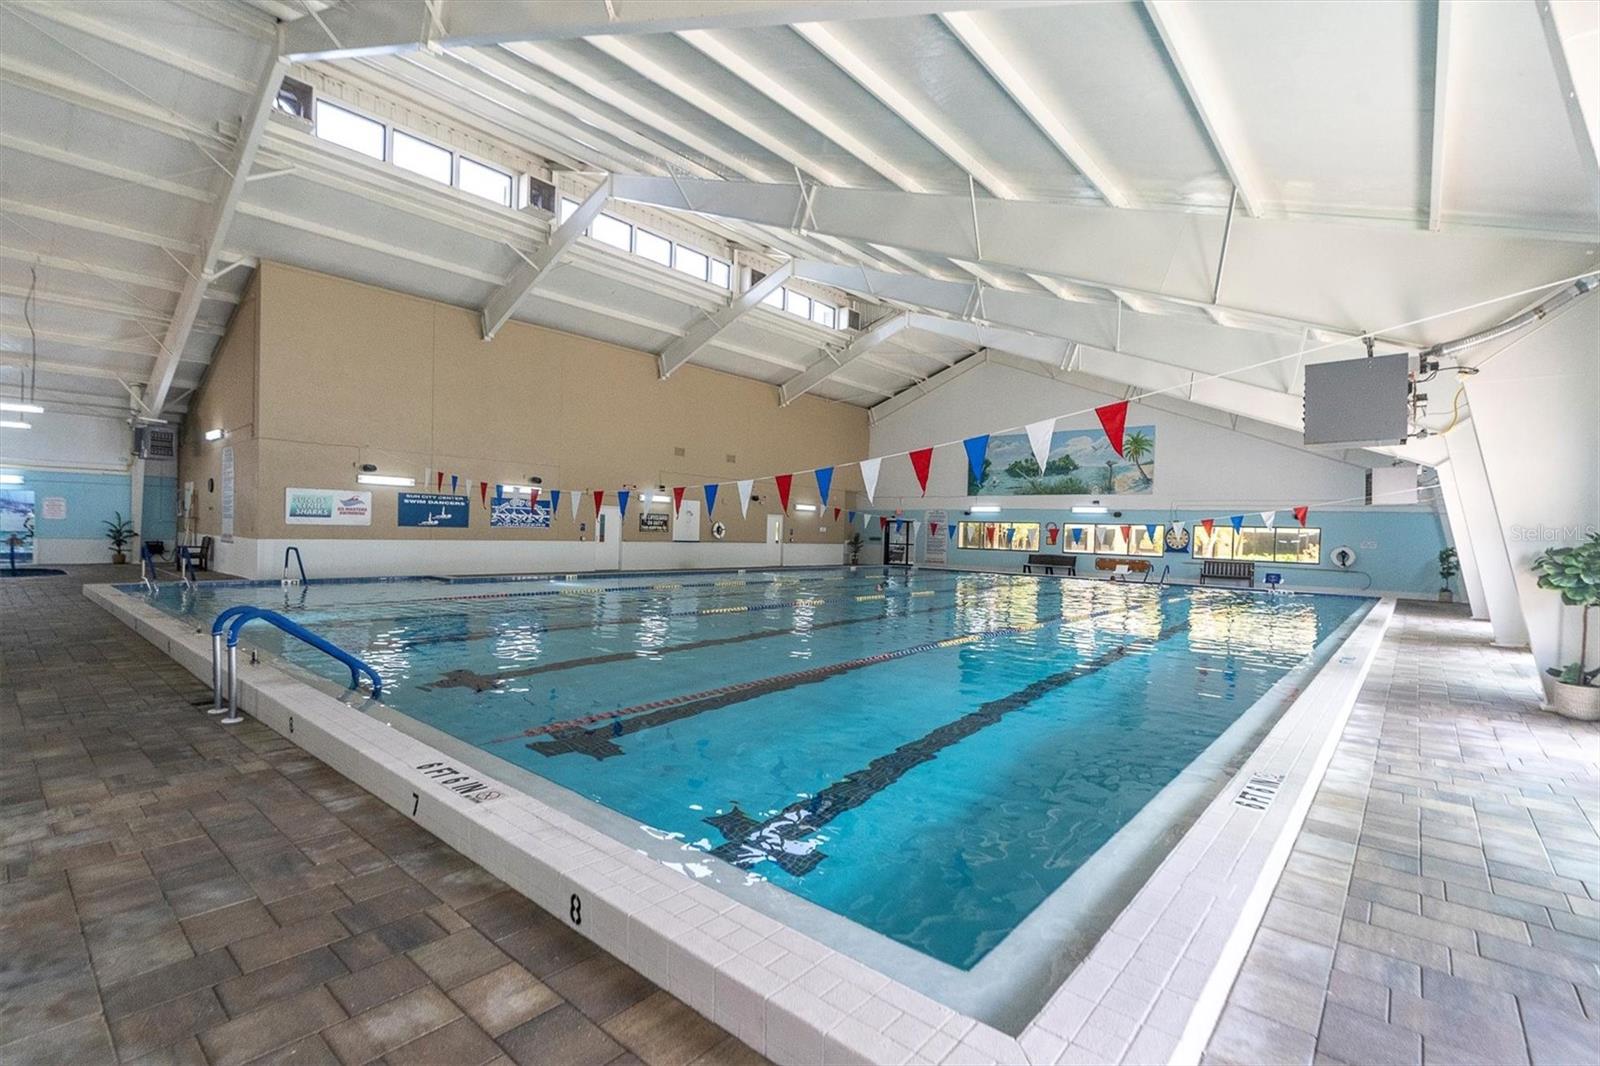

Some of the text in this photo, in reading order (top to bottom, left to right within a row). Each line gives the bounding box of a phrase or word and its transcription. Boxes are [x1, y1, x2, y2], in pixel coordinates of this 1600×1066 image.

[295, 508, 328, 516] SHARKS
[424, 767, 460, 779] FT
[442, 776, 470, 784] 6
[452, 781, 489, 795] IN
[1246, 785, 1275, 794] 6
[1239, 791, 1272, 804] FT
[412, 792, 419, 817] 7
[1235, 801, 1265, 810] 6
[570, 893, 582, 925] 8
